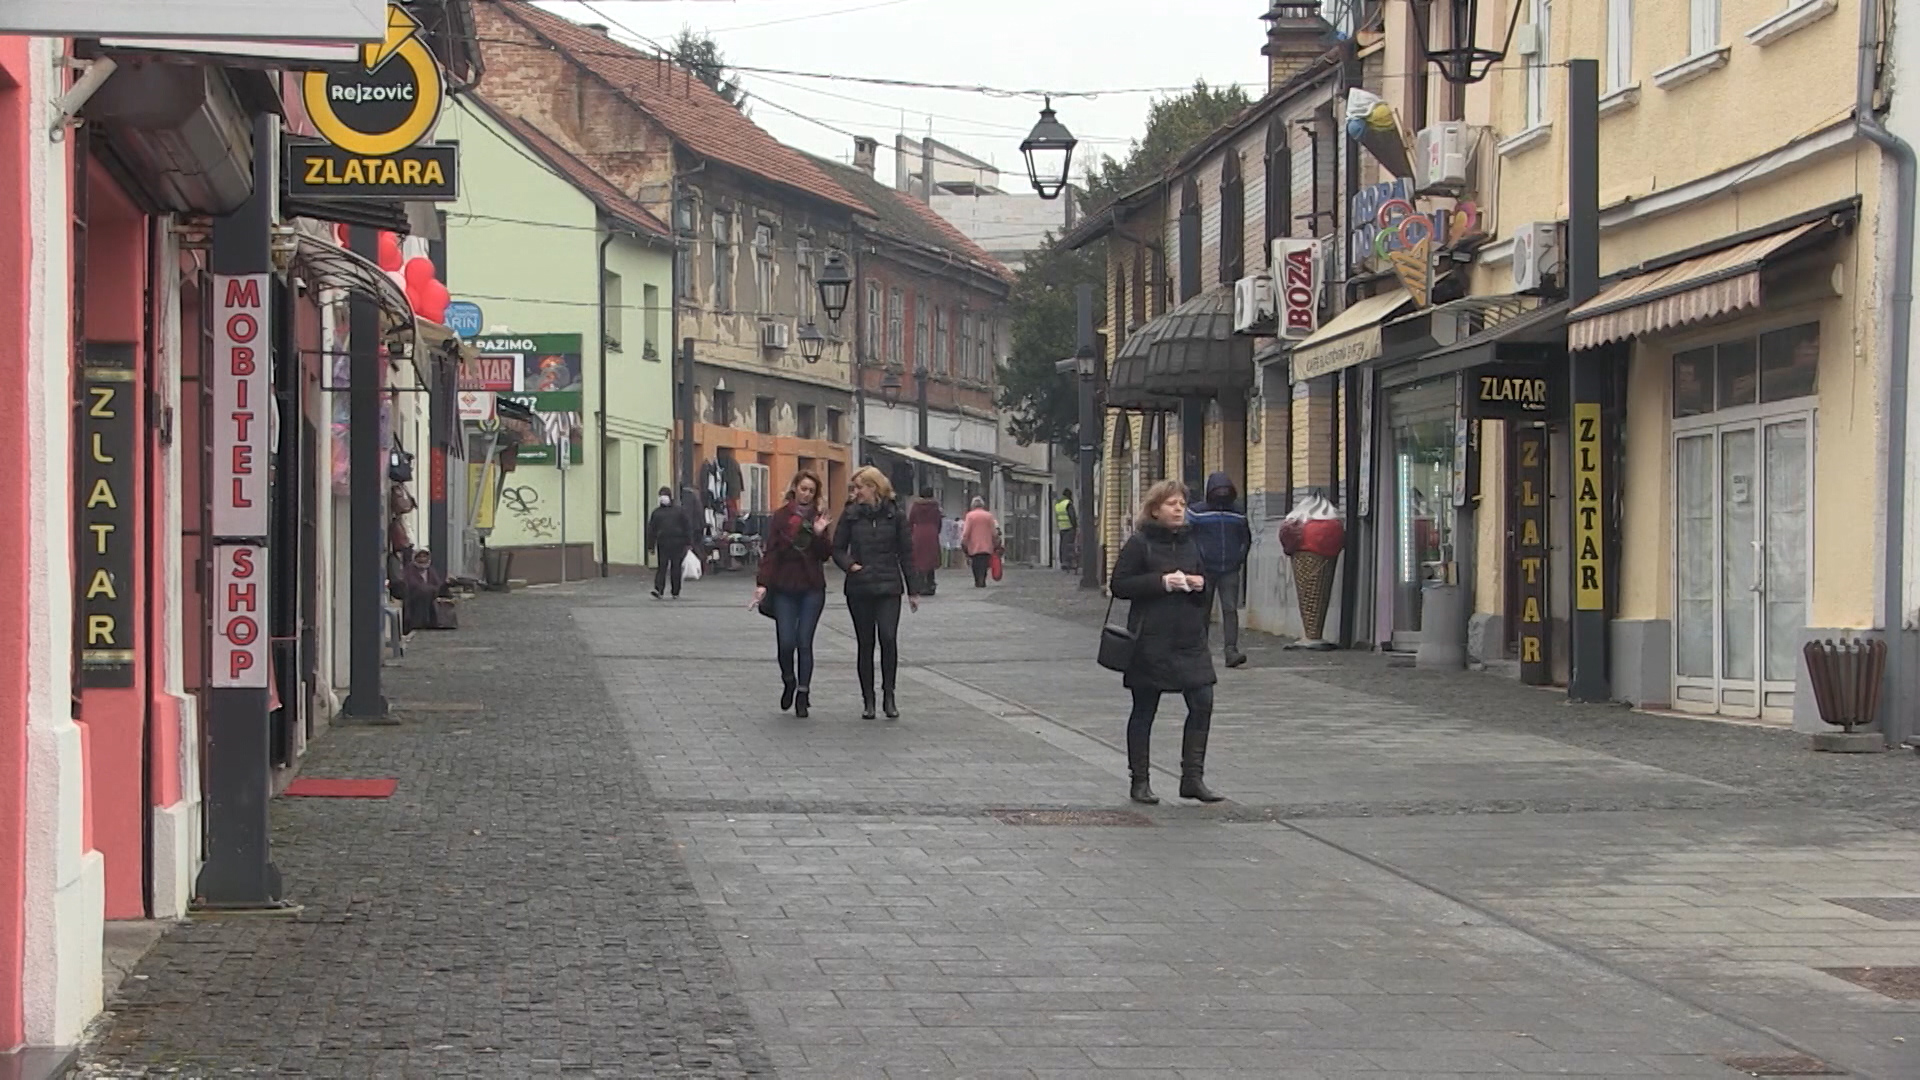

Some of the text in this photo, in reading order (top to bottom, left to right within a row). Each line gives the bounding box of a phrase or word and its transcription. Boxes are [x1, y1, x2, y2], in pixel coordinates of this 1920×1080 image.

[331, 83, 414, 104] Rejzović
[304, 157, 446, 185] ZLATARA
[1286, 247, 1313, 329] BOZA
[224, 278, 261, 509] MOBITEL
[1480, 376, 1546, 402] ZLATAR
[86, 387, 118, 645] ZLATAR
[1521, 441, 1541, 663] ZLATAR
[1579, 418, 1599, 590] ZLATAR
[226, 549, 259, 680] SHOP
